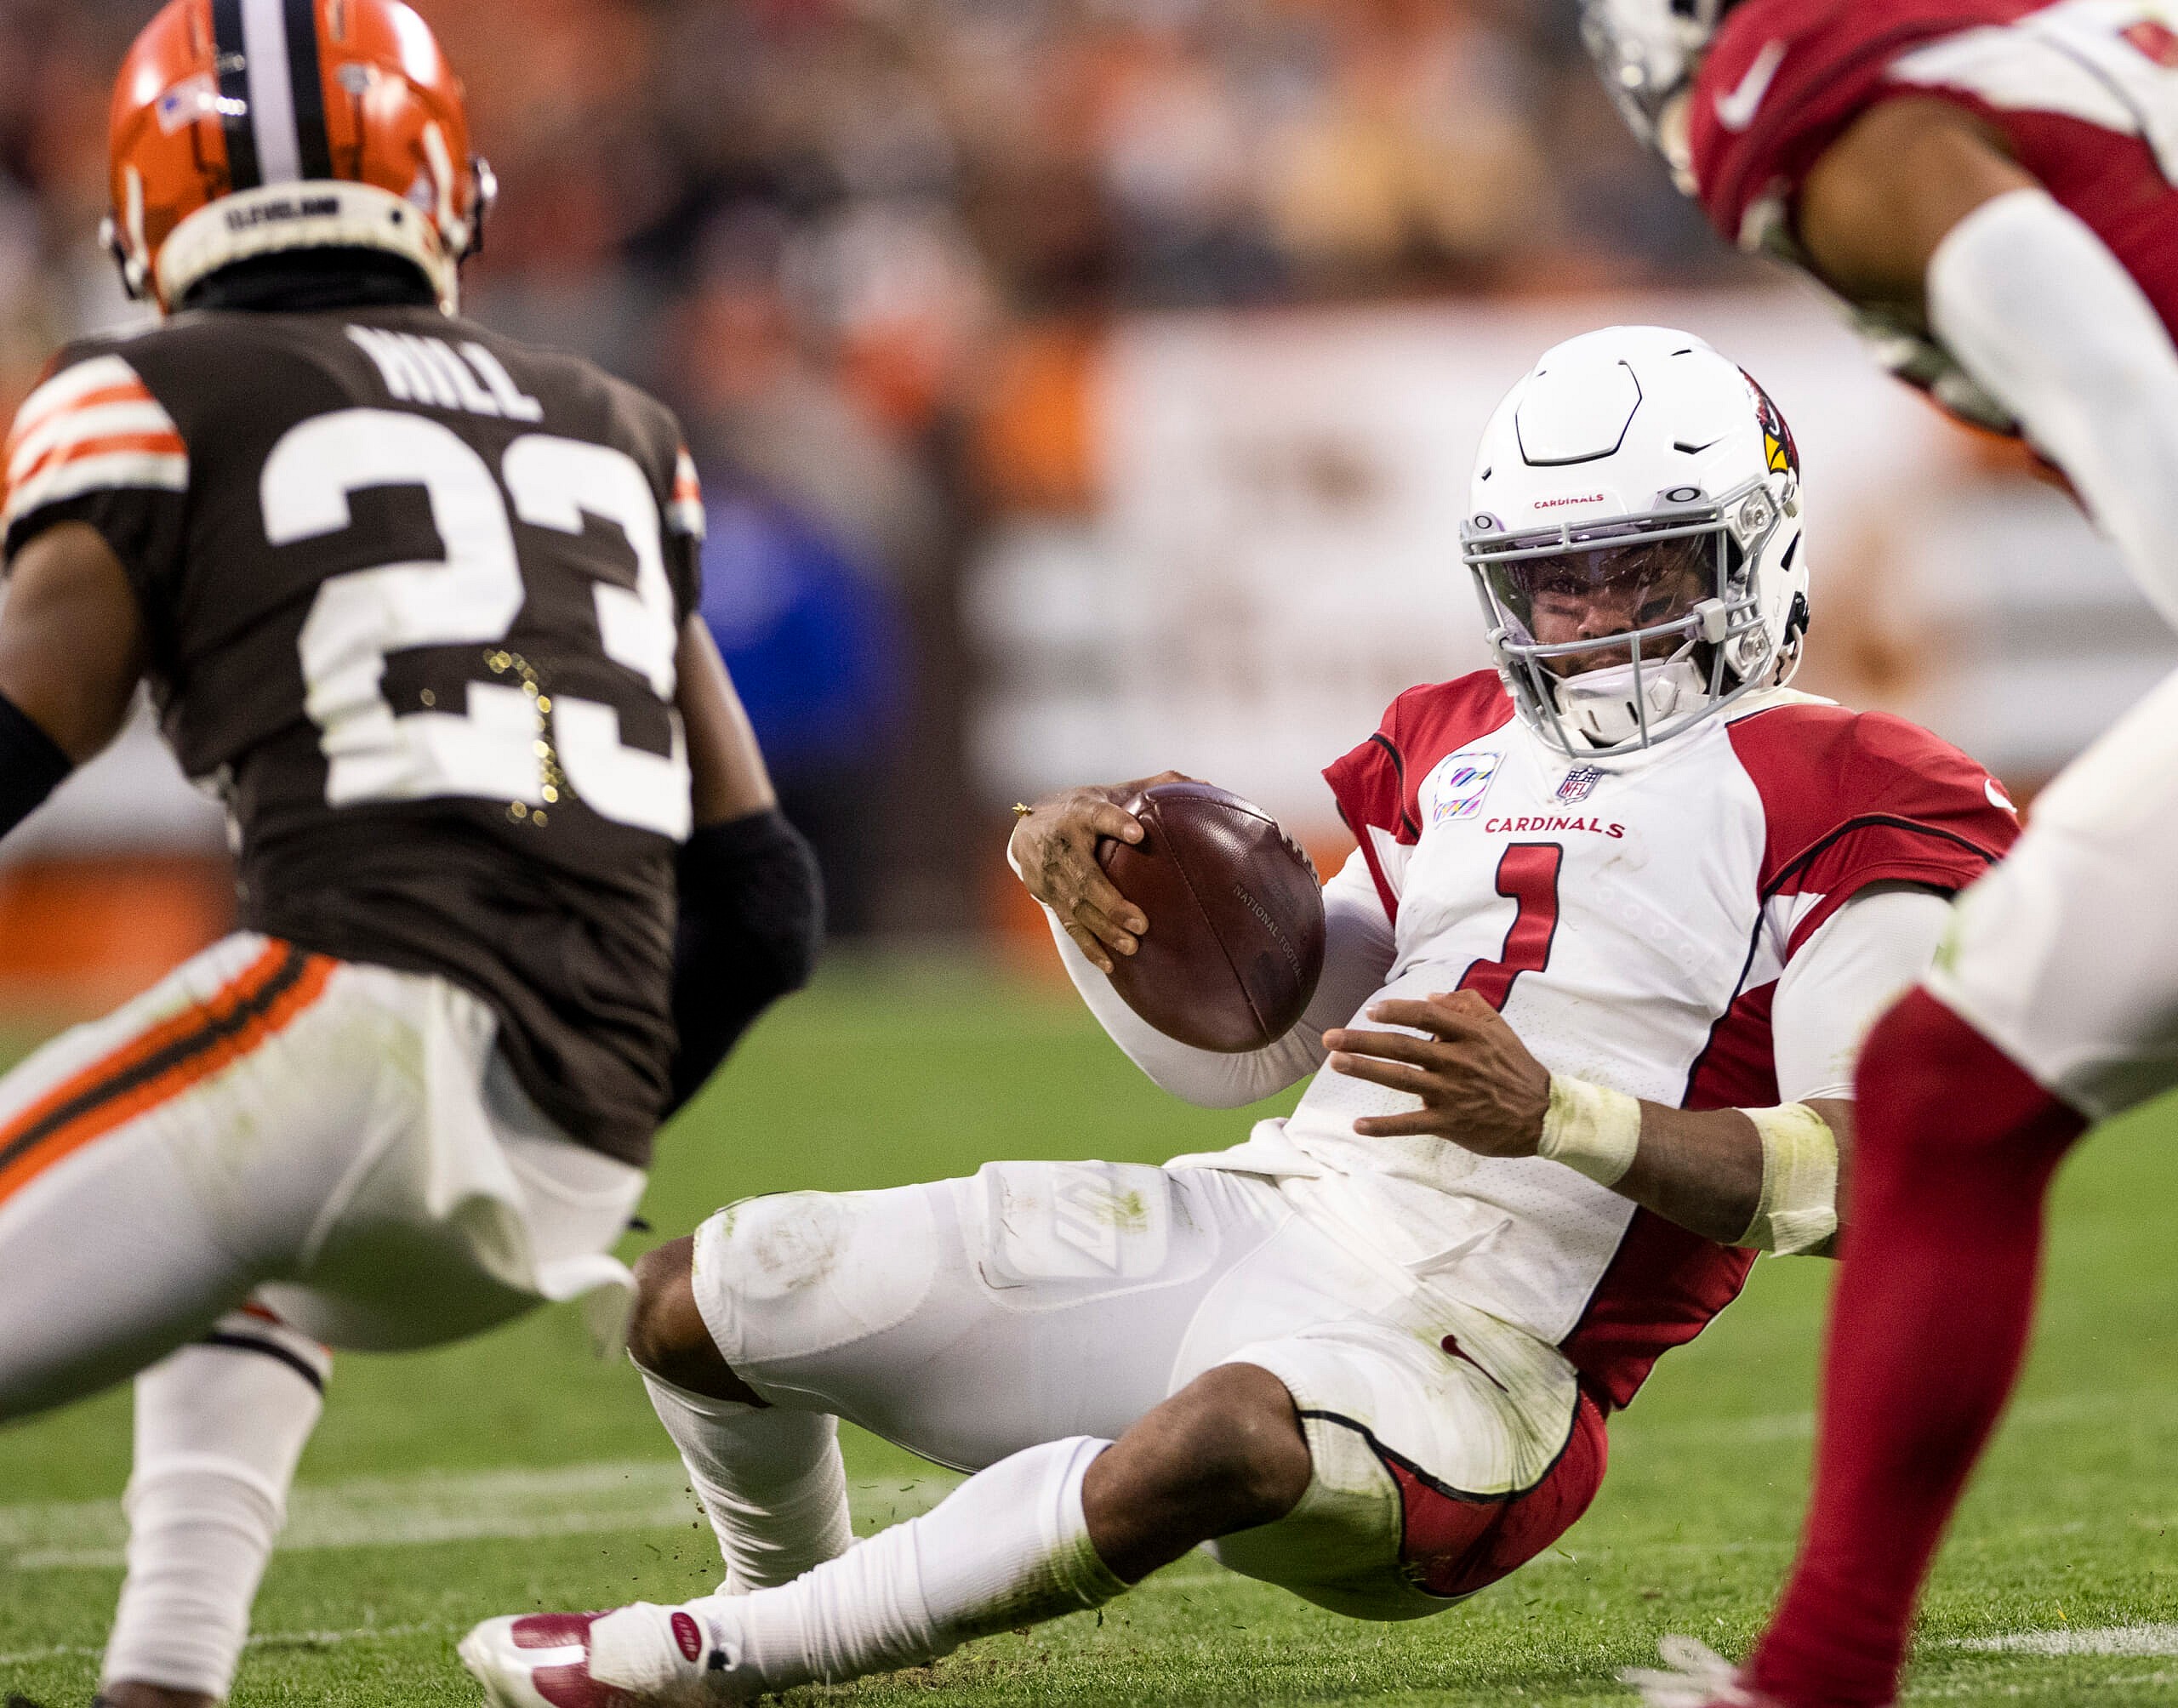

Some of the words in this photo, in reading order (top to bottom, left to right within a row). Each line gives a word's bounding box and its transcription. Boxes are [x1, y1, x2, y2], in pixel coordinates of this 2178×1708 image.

[344, 323, 544, 423] HILL
[1533, 492, 1605, 510] CARDINALS
[259, 407, 693, 844] 23
[1559, 780, 1588, 799] NFL
[1485, 817, 1627, 840] CARDINALS
[1232, 883, 1279, 937] NATIONAL
[1454, 841, 1565, 1014] 1
